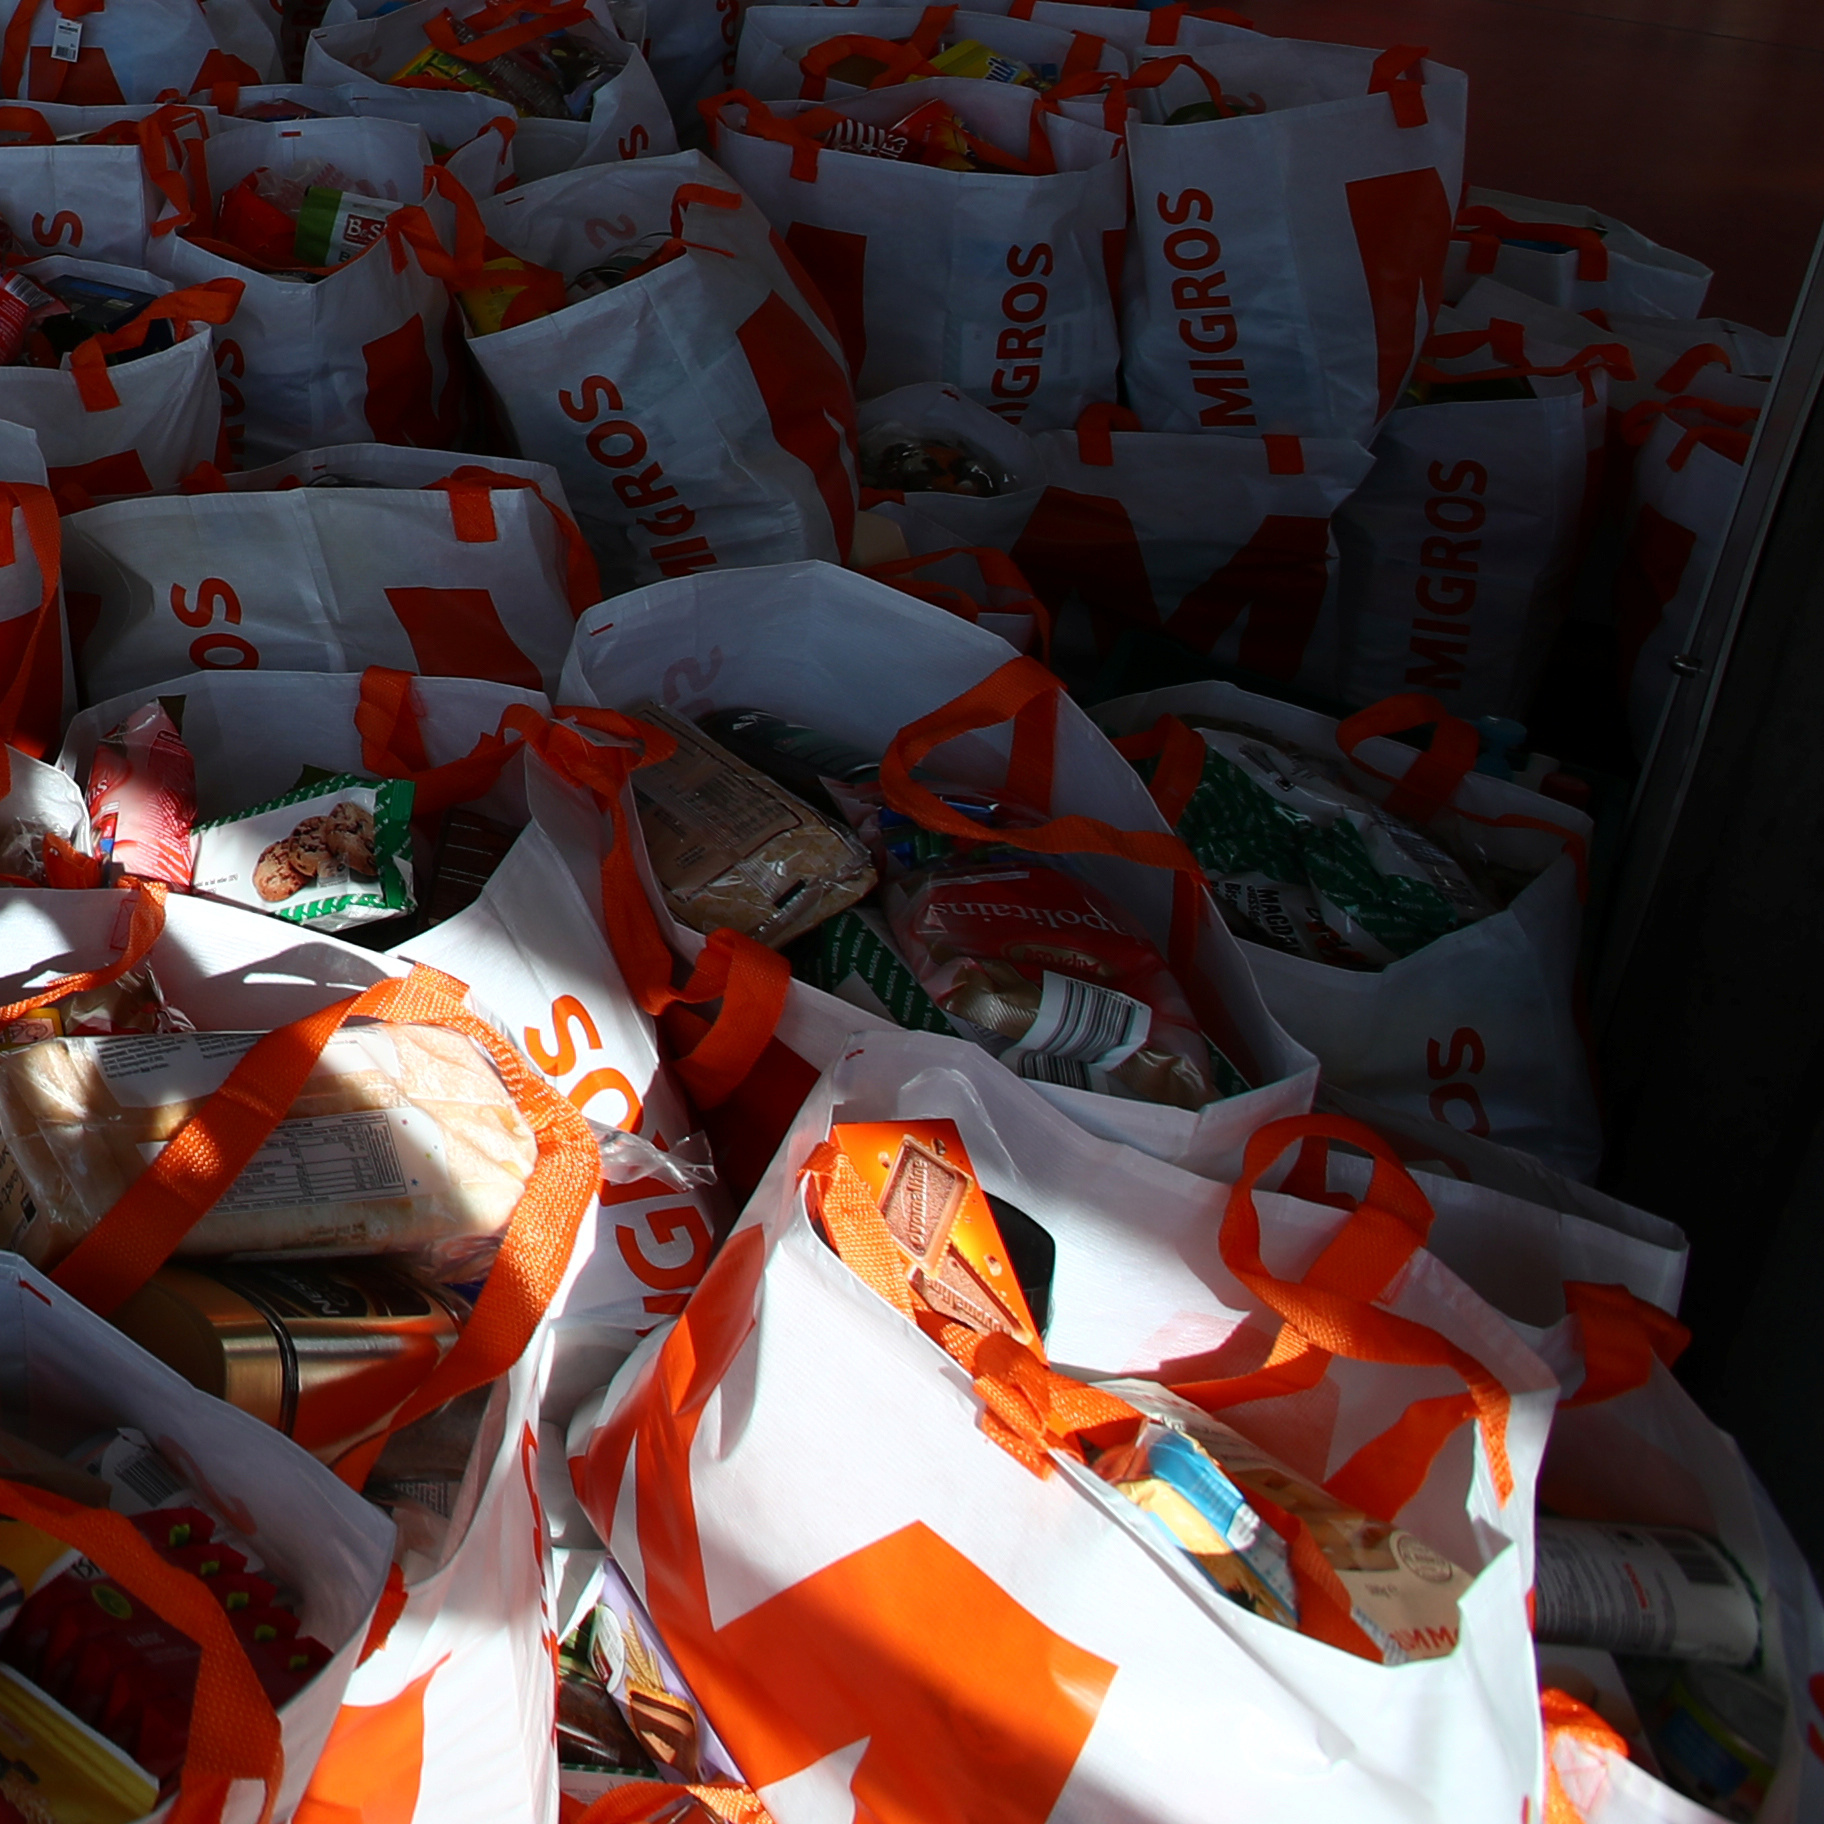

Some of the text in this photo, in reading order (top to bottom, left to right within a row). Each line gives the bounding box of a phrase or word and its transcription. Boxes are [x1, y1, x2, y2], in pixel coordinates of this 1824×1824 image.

[990, 242, 1054, 425] IGROS
[1158, 185, 1258, 429] MIGROS
[1404, 459, 1490, 691] MIGROS
